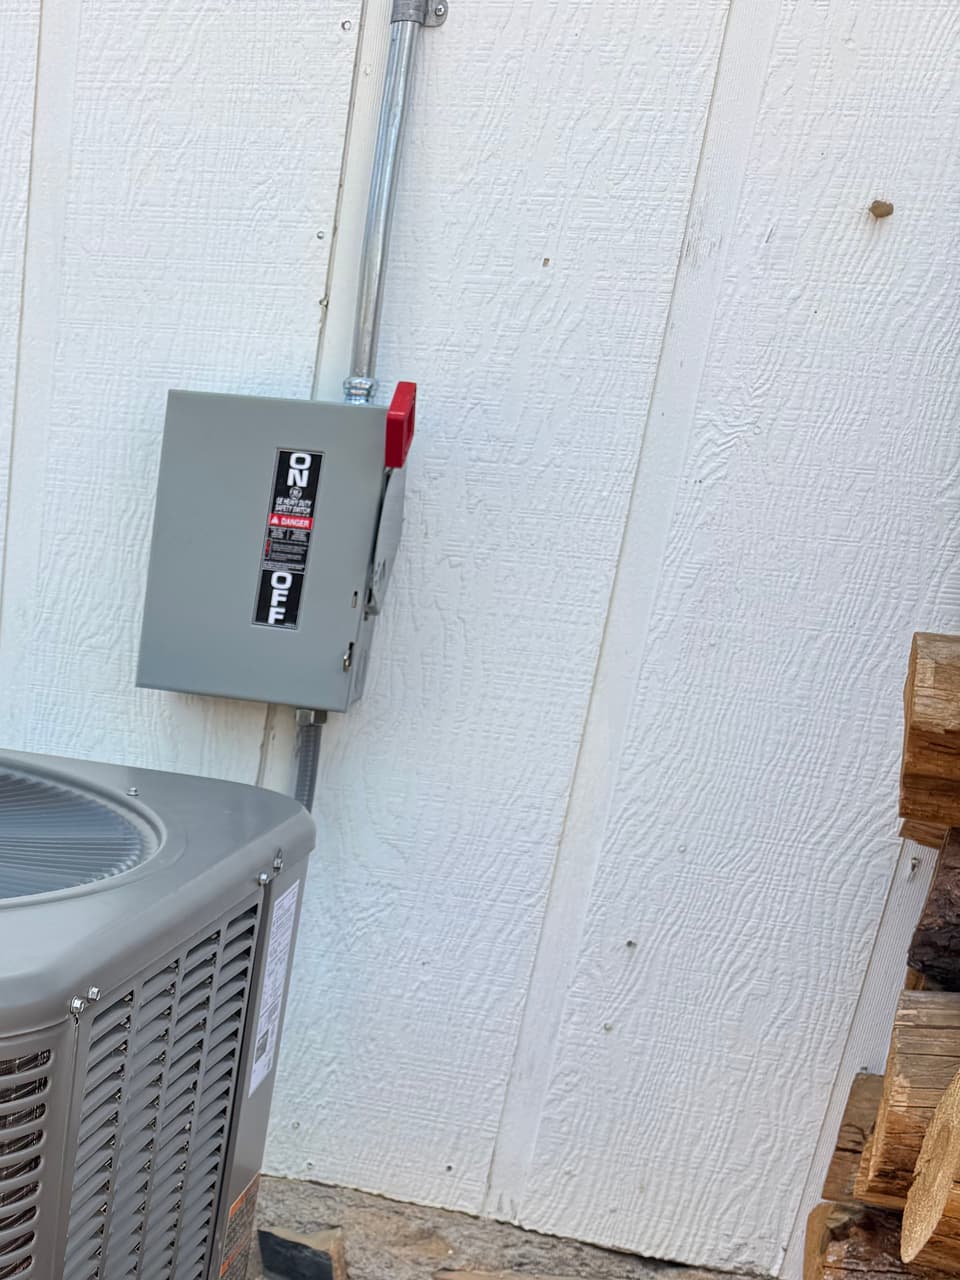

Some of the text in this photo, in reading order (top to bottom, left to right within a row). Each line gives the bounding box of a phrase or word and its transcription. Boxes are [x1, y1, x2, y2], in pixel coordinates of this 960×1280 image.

[287, 452, 312, 487] ON
[281, 517, 309, 528] DANGER
[268, 571, 292, 624] OFF
